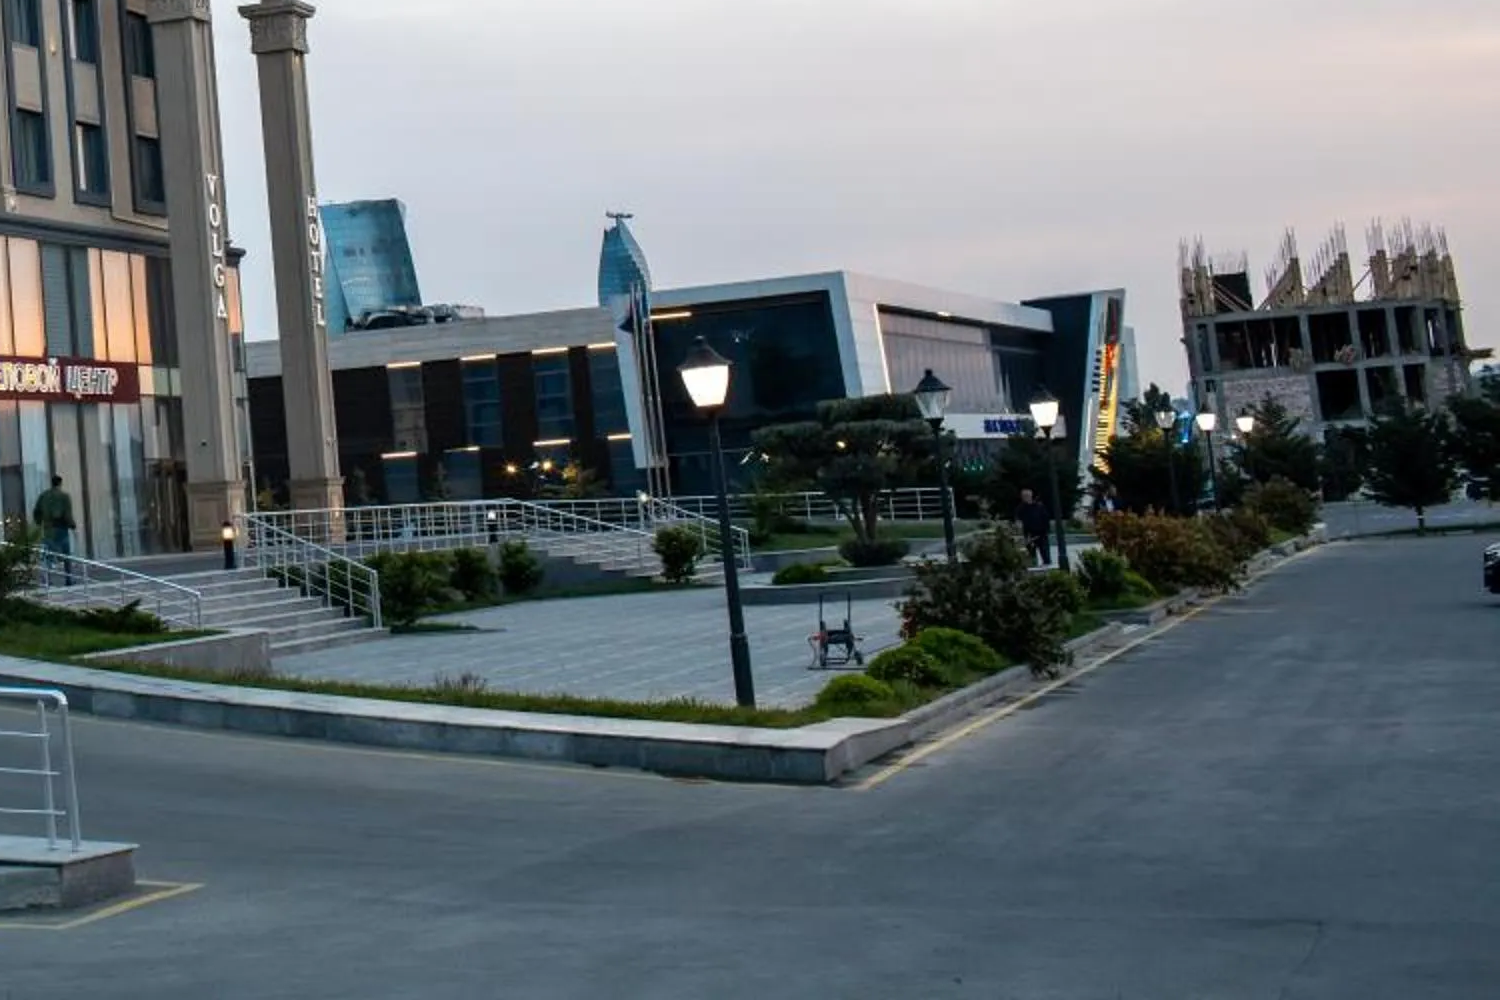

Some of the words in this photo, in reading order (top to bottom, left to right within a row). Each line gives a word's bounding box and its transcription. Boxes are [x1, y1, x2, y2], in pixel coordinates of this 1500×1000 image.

[206, 173, 228, 319] VOLGA
[307, 196, 326, 327] HOTEL
[64, 364, 119, 399] ЦЕНТР
